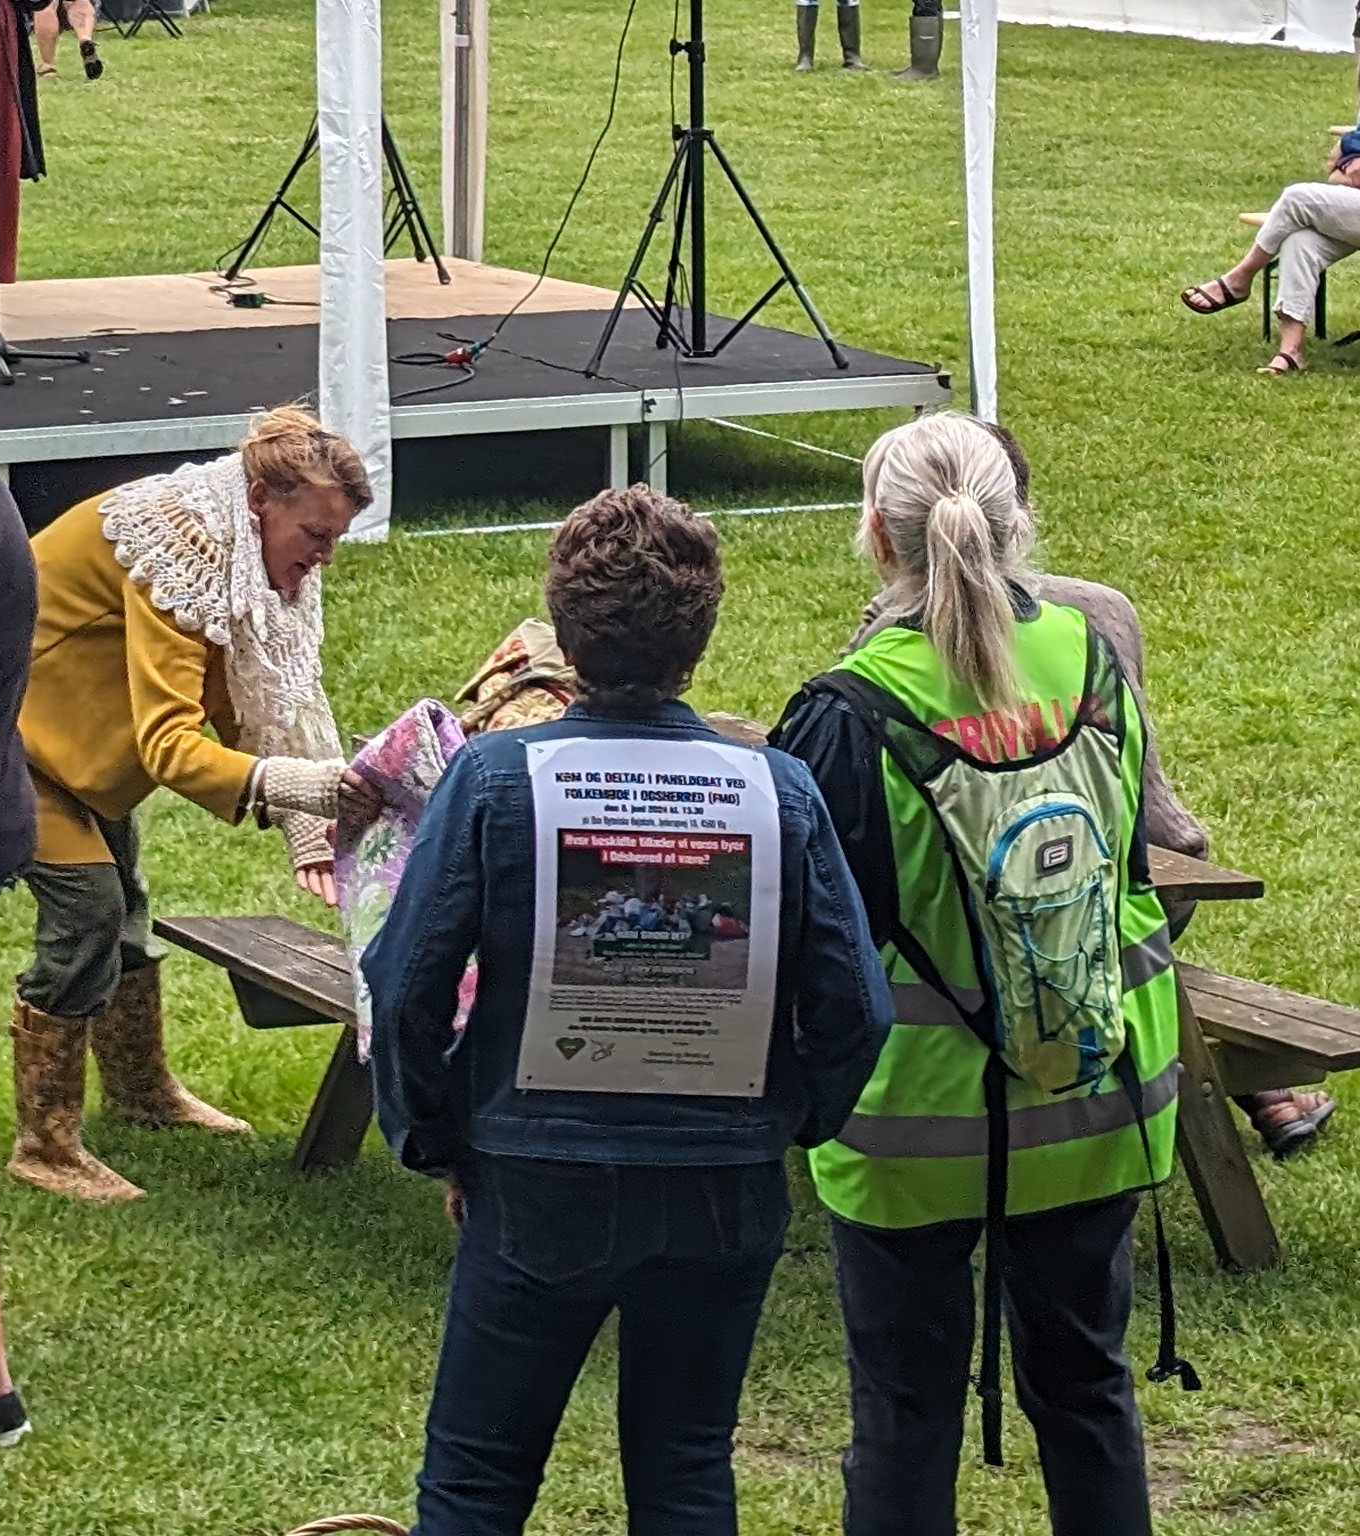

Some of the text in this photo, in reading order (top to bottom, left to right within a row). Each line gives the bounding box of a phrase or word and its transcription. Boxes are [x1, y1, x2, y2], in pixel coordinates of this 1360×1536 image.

[555, 772, 582, 782] KOM
[585, 772, 601, 783] OG
[604, 772, 645, 784] DELTAG
[655, 774, 722, 787] PANELDEBAT
[725, 777, 746, 789] VED
[640, 790, 705, 803] ODSHERRED
